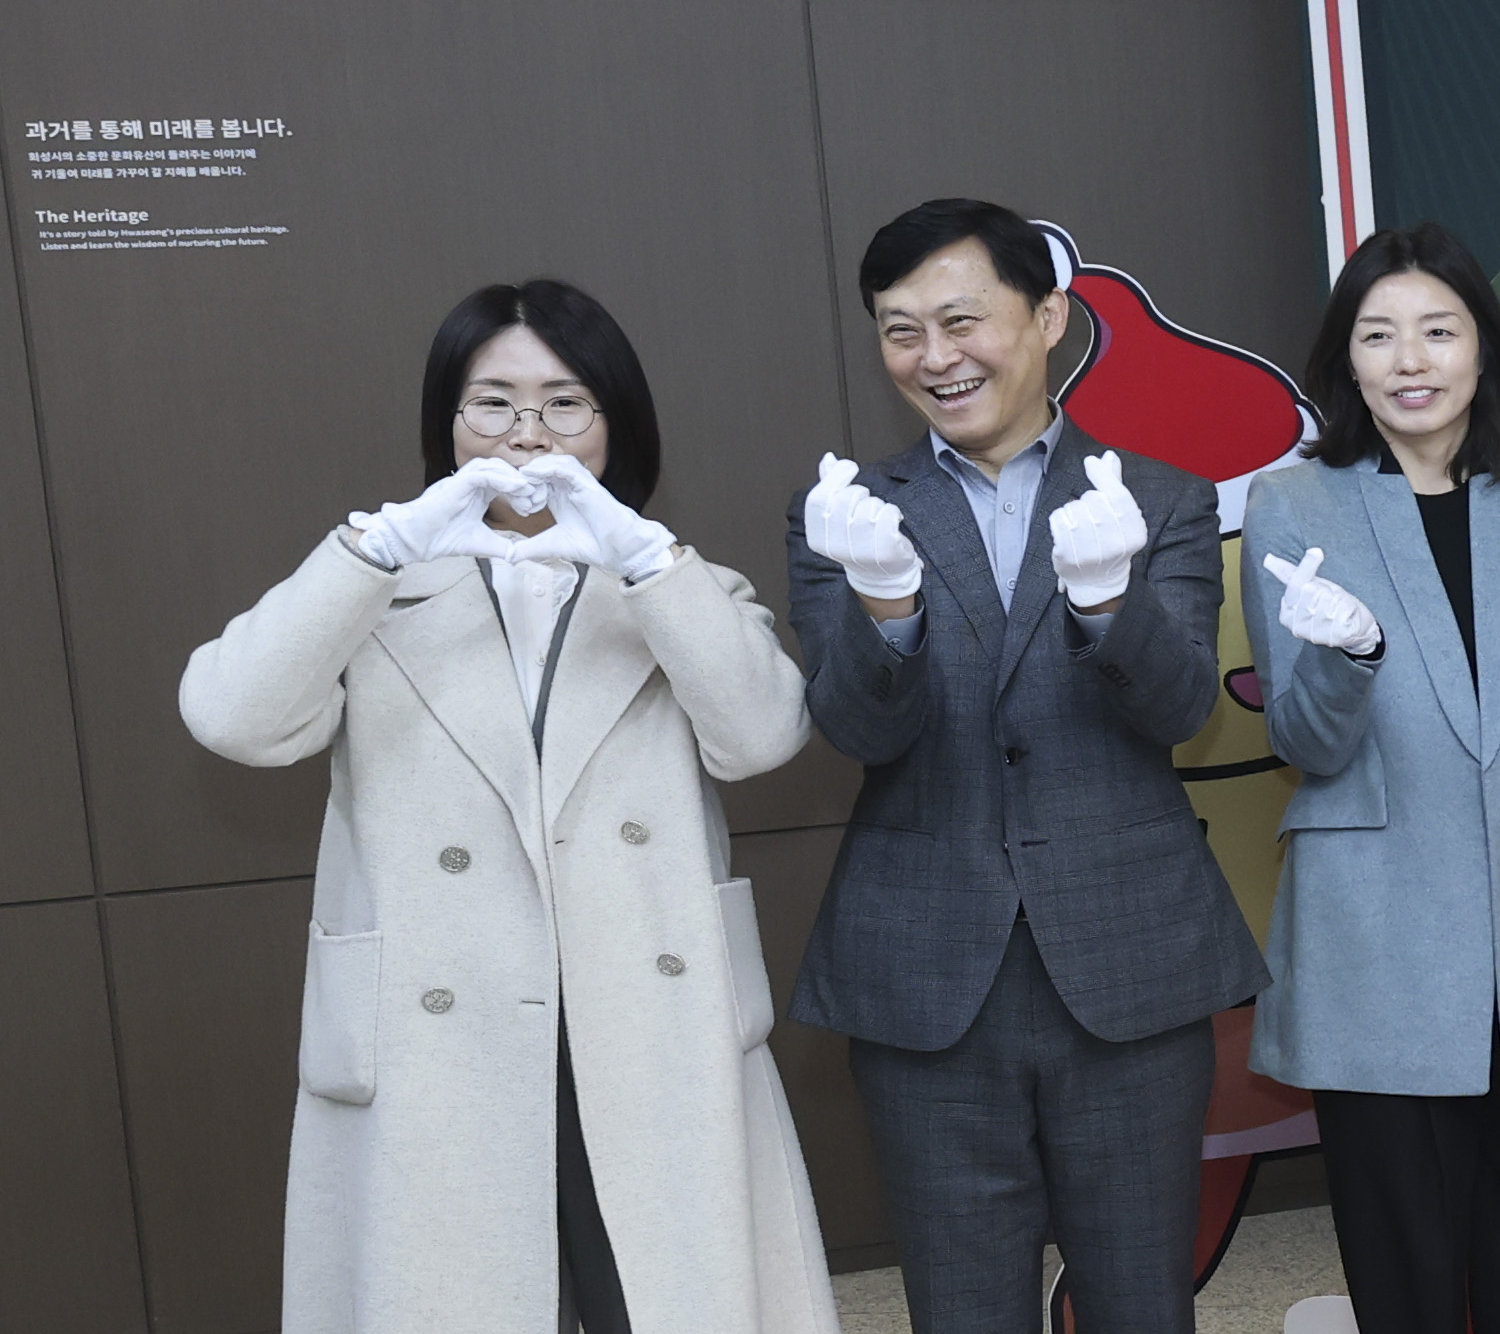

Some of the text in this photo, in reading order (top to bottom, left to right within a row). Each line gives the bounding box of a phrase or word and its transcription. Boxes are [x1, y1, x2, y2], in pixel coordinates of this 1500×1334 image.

[25, 118, 293, 141] 과거를 통해 미래를 봅니다.
[116, 168, 148, 178] 가꾸어
[35, 209, 149, 225] The Heritage
[63, 231, 86, 239] story
[108, 229, 119, 238] by
[176, 227, 214, 237] precious
[215, 226, 249, 234] cultural
[70, 242, 88, 250] and
[131, 240, 166, 248] wisdom
[179, 239, 221, 248] nurturing
